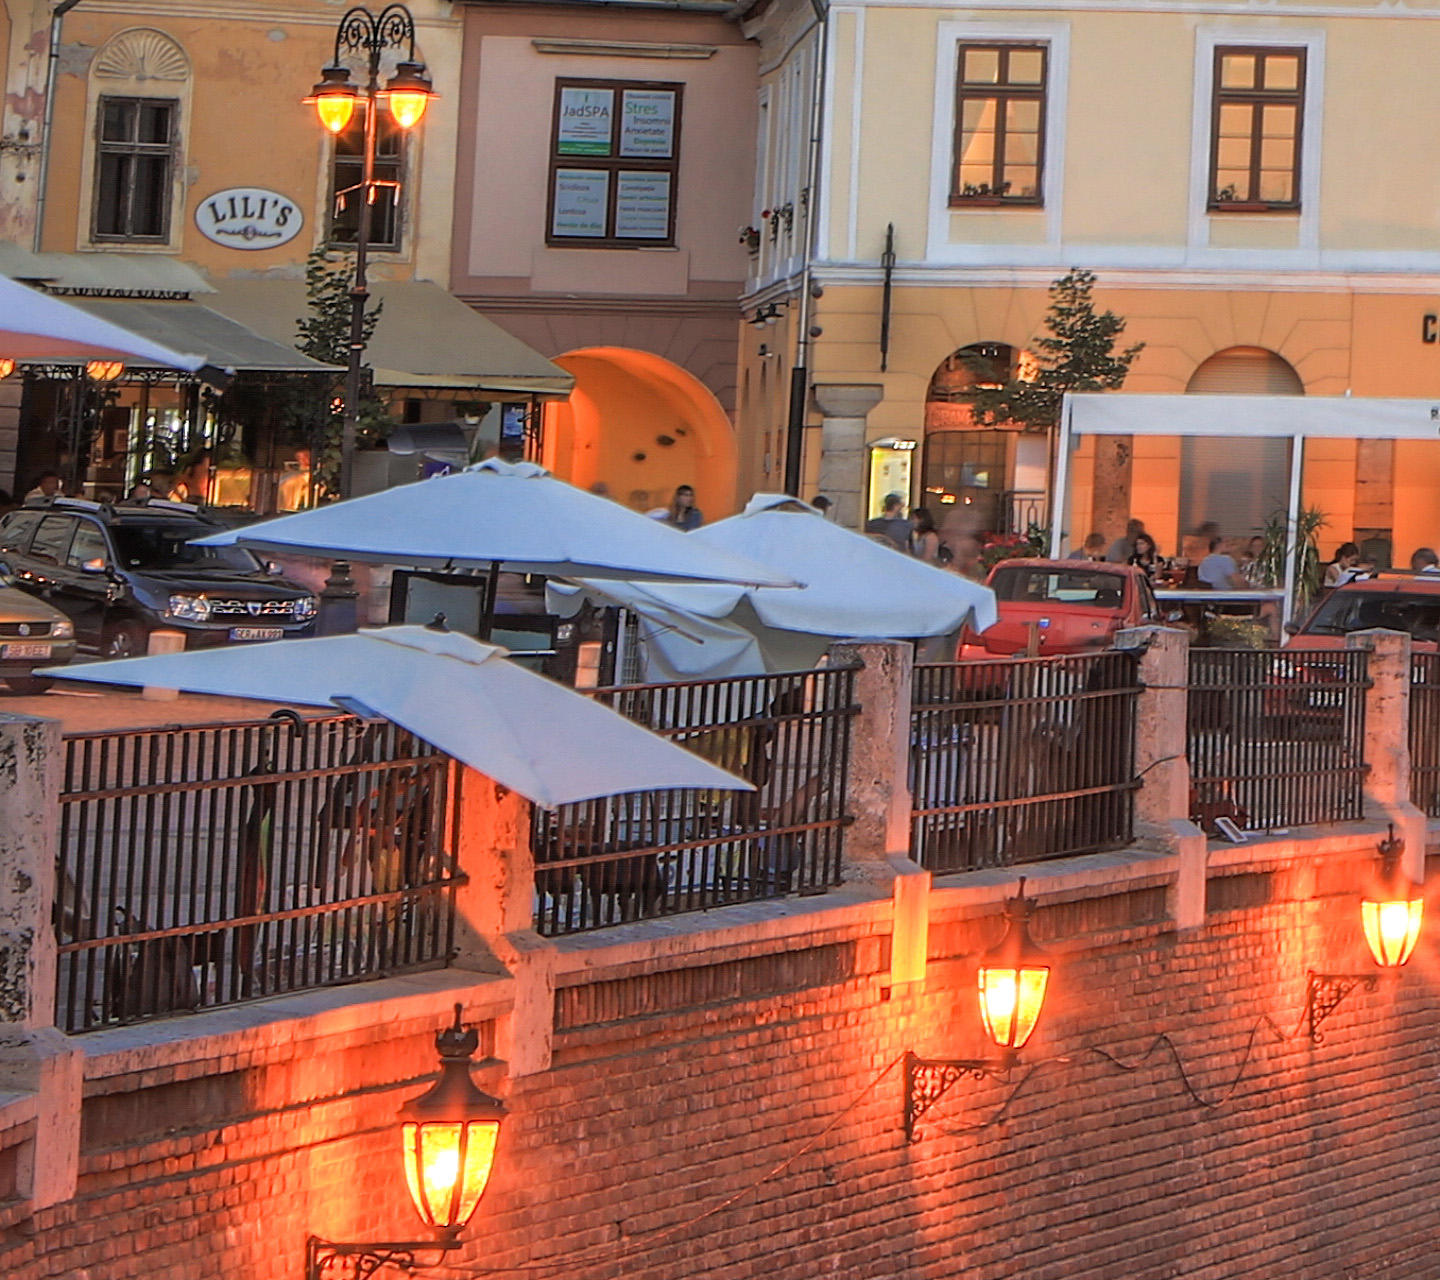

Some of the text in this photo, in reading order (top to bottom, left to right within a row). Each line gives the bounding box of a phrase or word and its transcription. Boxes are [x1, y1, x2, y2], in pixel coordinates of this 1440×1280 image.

[563, 105, 610, 118] JadSPA
[625, 102, 659, 115] Stres
[207, 196, 292, 227] LILI'S
